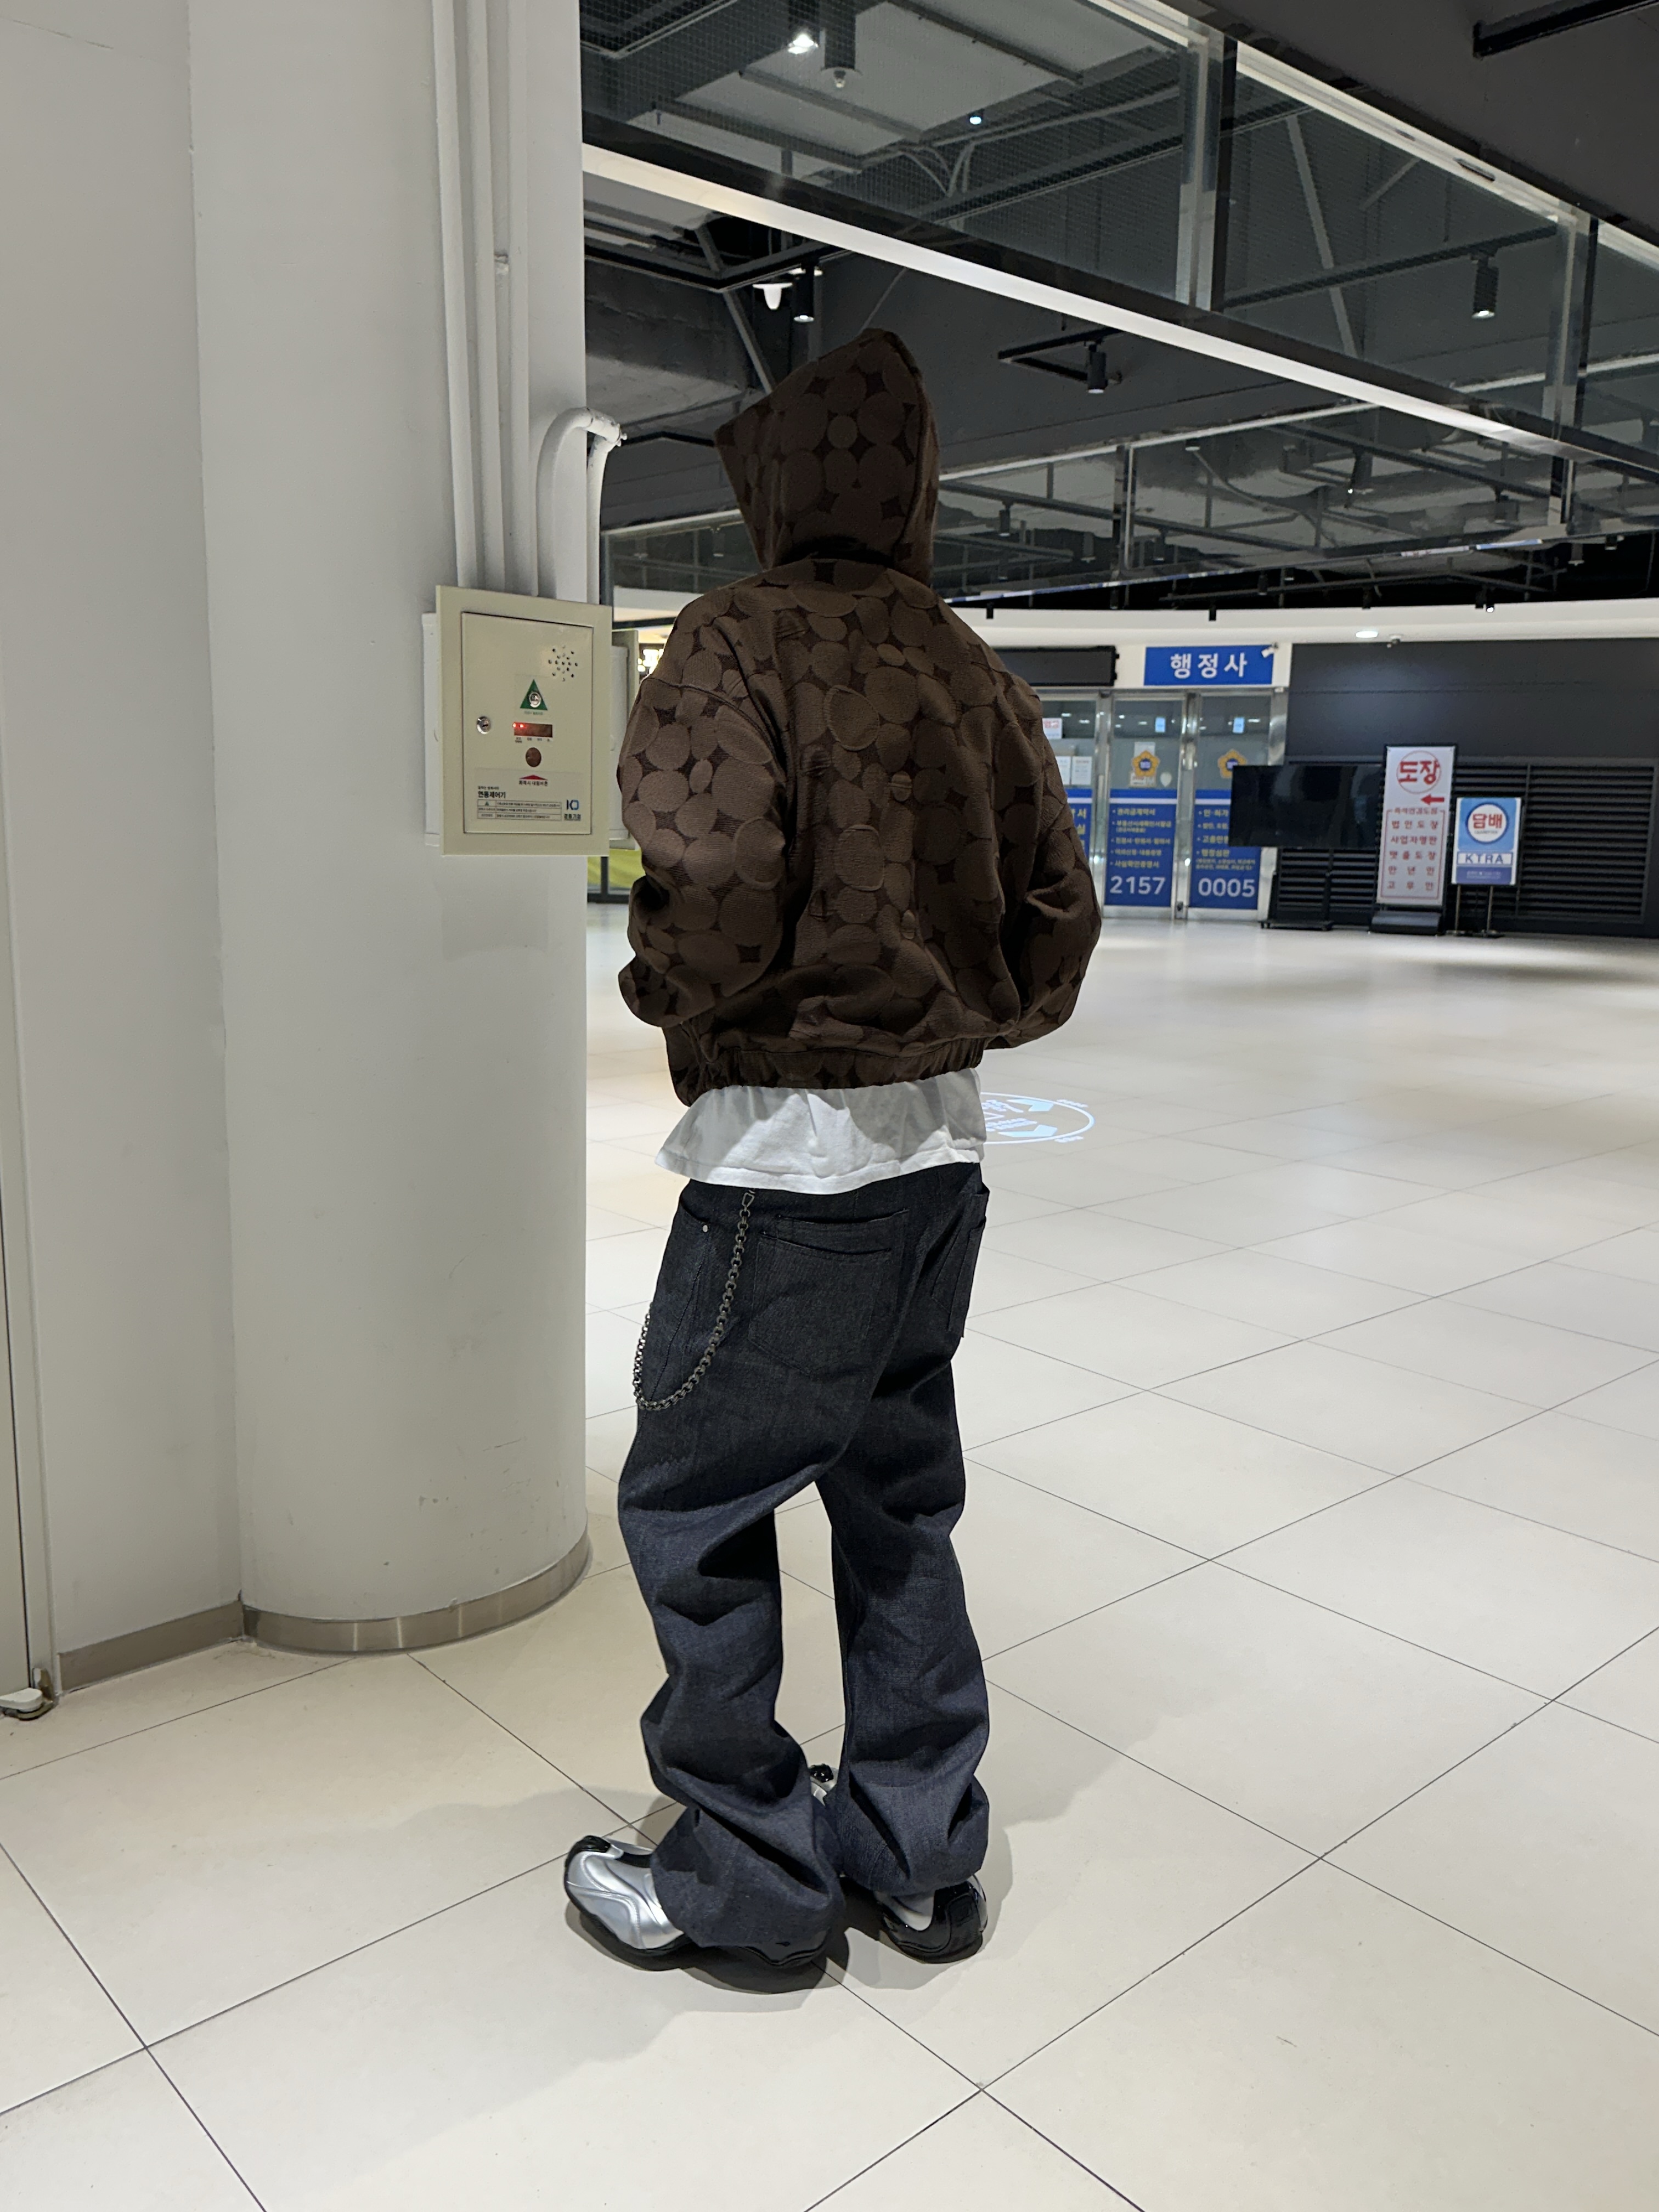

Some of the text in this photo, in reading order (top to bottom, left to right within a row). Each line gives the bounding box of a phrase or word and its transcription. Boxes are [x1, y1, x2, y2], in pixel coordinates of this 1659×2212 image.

[1170, 652, 1248, 679] 행정사
[1398, 760, 1441, 785] 도장
[1472, 813, 1503, 829] 담배
[1110, 876, 1165, 894] 2157
[1198, 878, 1255, 898] 0005
